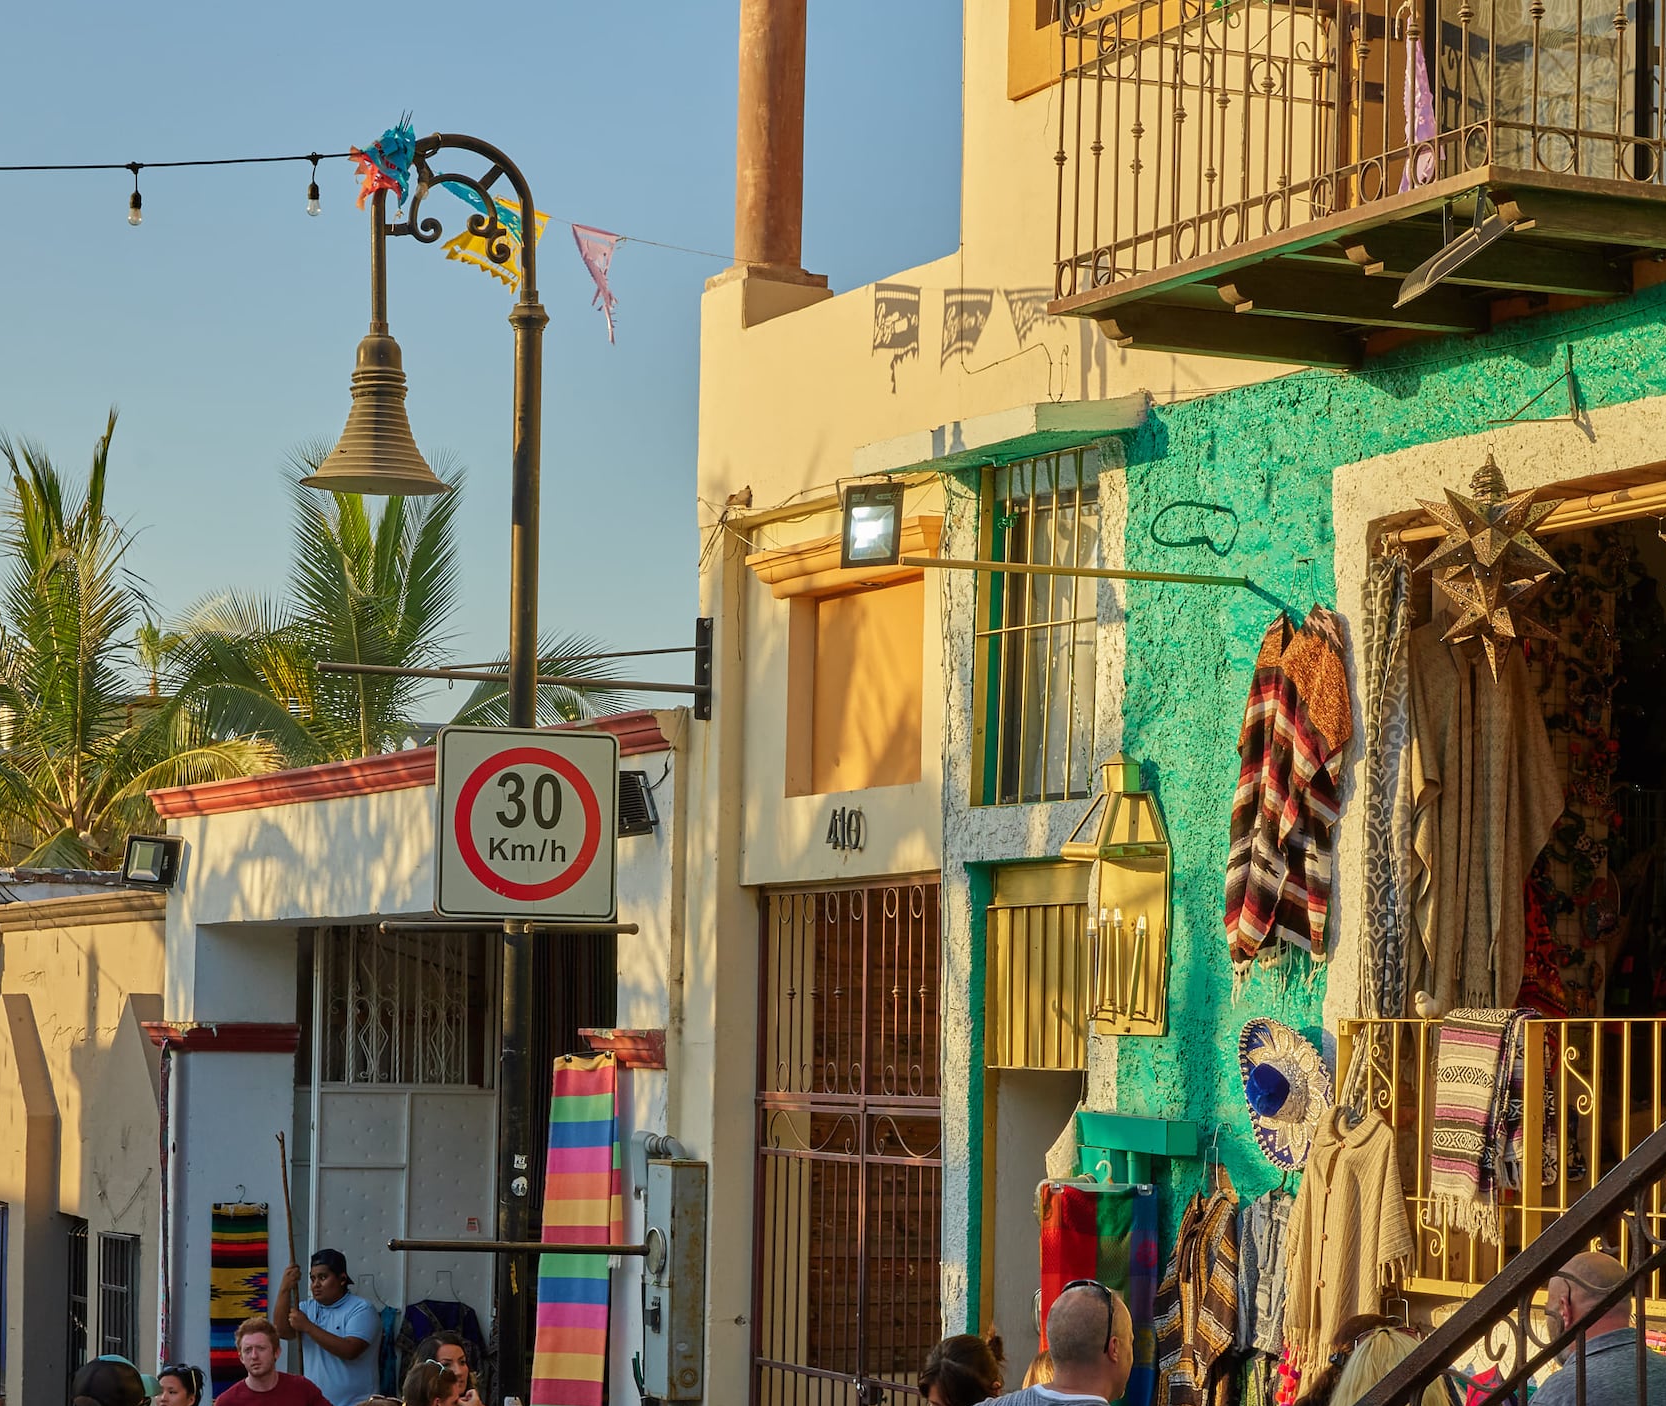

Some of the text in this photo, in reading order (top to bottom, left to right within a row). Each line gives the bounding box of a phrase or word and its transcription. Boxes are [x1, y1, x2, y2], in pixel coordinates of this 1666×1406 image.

[496, 772, 562, 830] 30
[489, 837, 566, 862] Km/h
[826, 807, 861, 850] 410
